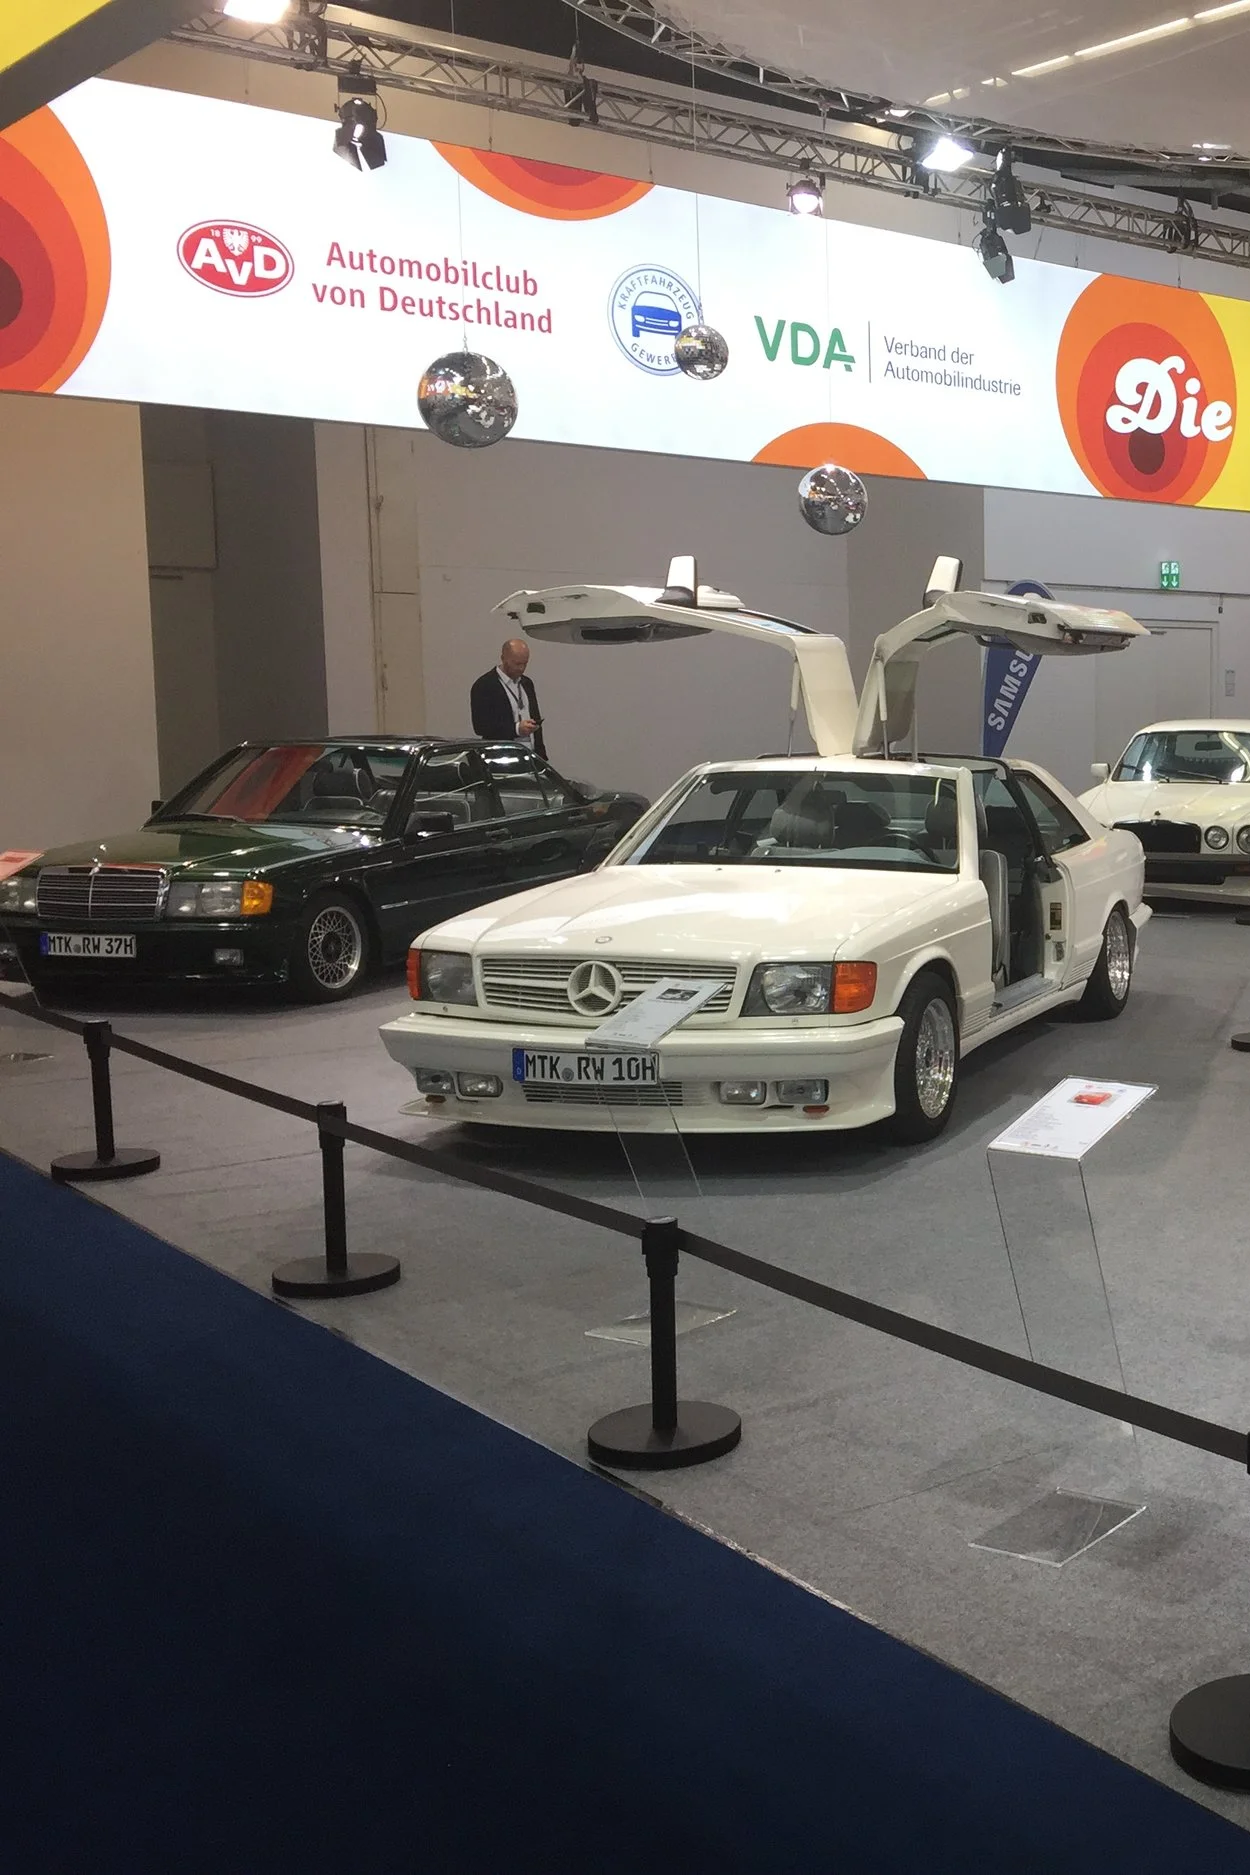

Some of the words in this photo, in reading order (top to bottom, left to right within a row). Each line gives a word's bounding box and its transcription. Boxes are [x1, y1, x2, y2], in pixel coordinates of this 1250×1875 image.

[326, 241, 538, 297] Automobilclub
[312, 282, 366, 309] von
[379, 286, 552, 334] Deutschland
[618, 274, 695, 320] KRAFTFAHRZEUG
[754, 315, 856, 372] VDA
[884, 336, 946, 361] Verband
[951, 347, 975, 366] der
[884, 361, 1021, 396] Automobilindustrie
[1105, 355, 1233, 442] Die
[48, 936, 72, 953] MTK
[82, 937, 101, 954] RW
[104, 937, 135, 954] 37H
[525, 1054, 561, 1080] MTK
[577, 1056, 605, 1080] RW
[612, 1056, 657, 1081] 10H
